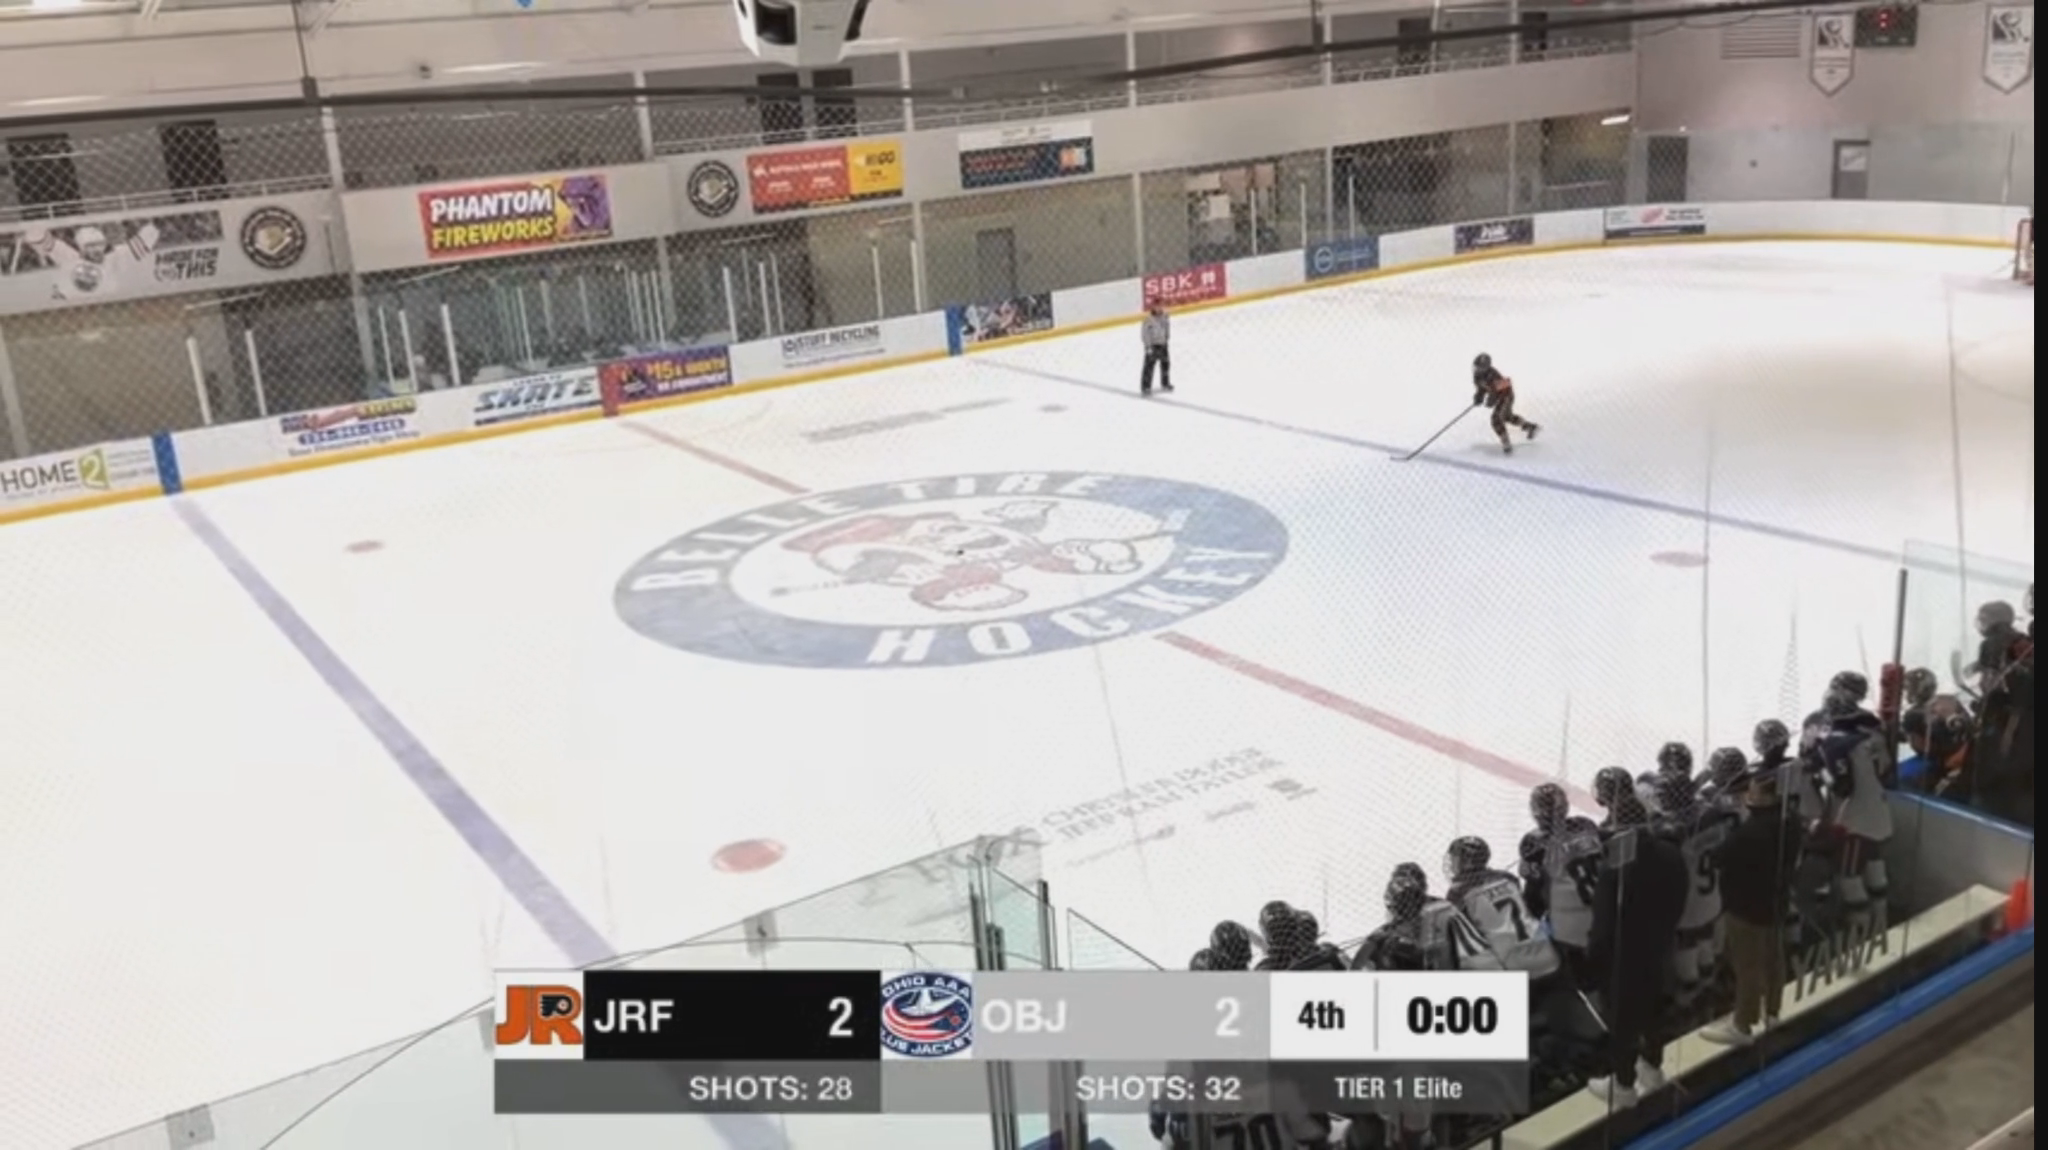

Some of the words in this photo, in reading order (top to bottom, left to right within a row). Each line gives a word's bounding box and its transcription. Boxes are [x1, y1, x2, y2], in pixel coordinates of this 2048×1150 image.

[430, 187, 554, 223] PHANTOM
[432, 216, 555, 249] FIREWORKS
[176, 259, 217, 280] THIS
[1145, 271, 1193, 296] SBK
[474, 376, 597, 413] SKATE
[1, 459, 78, 493] HOME
[80, 450, 109, 489] 2
[632, 492, 864, 594] BELLE
[886, 471, 1118, 502] TIRE
[866, 545, 1275, 665] HOCKEY
[1493, 896, 1531, 942] 7
